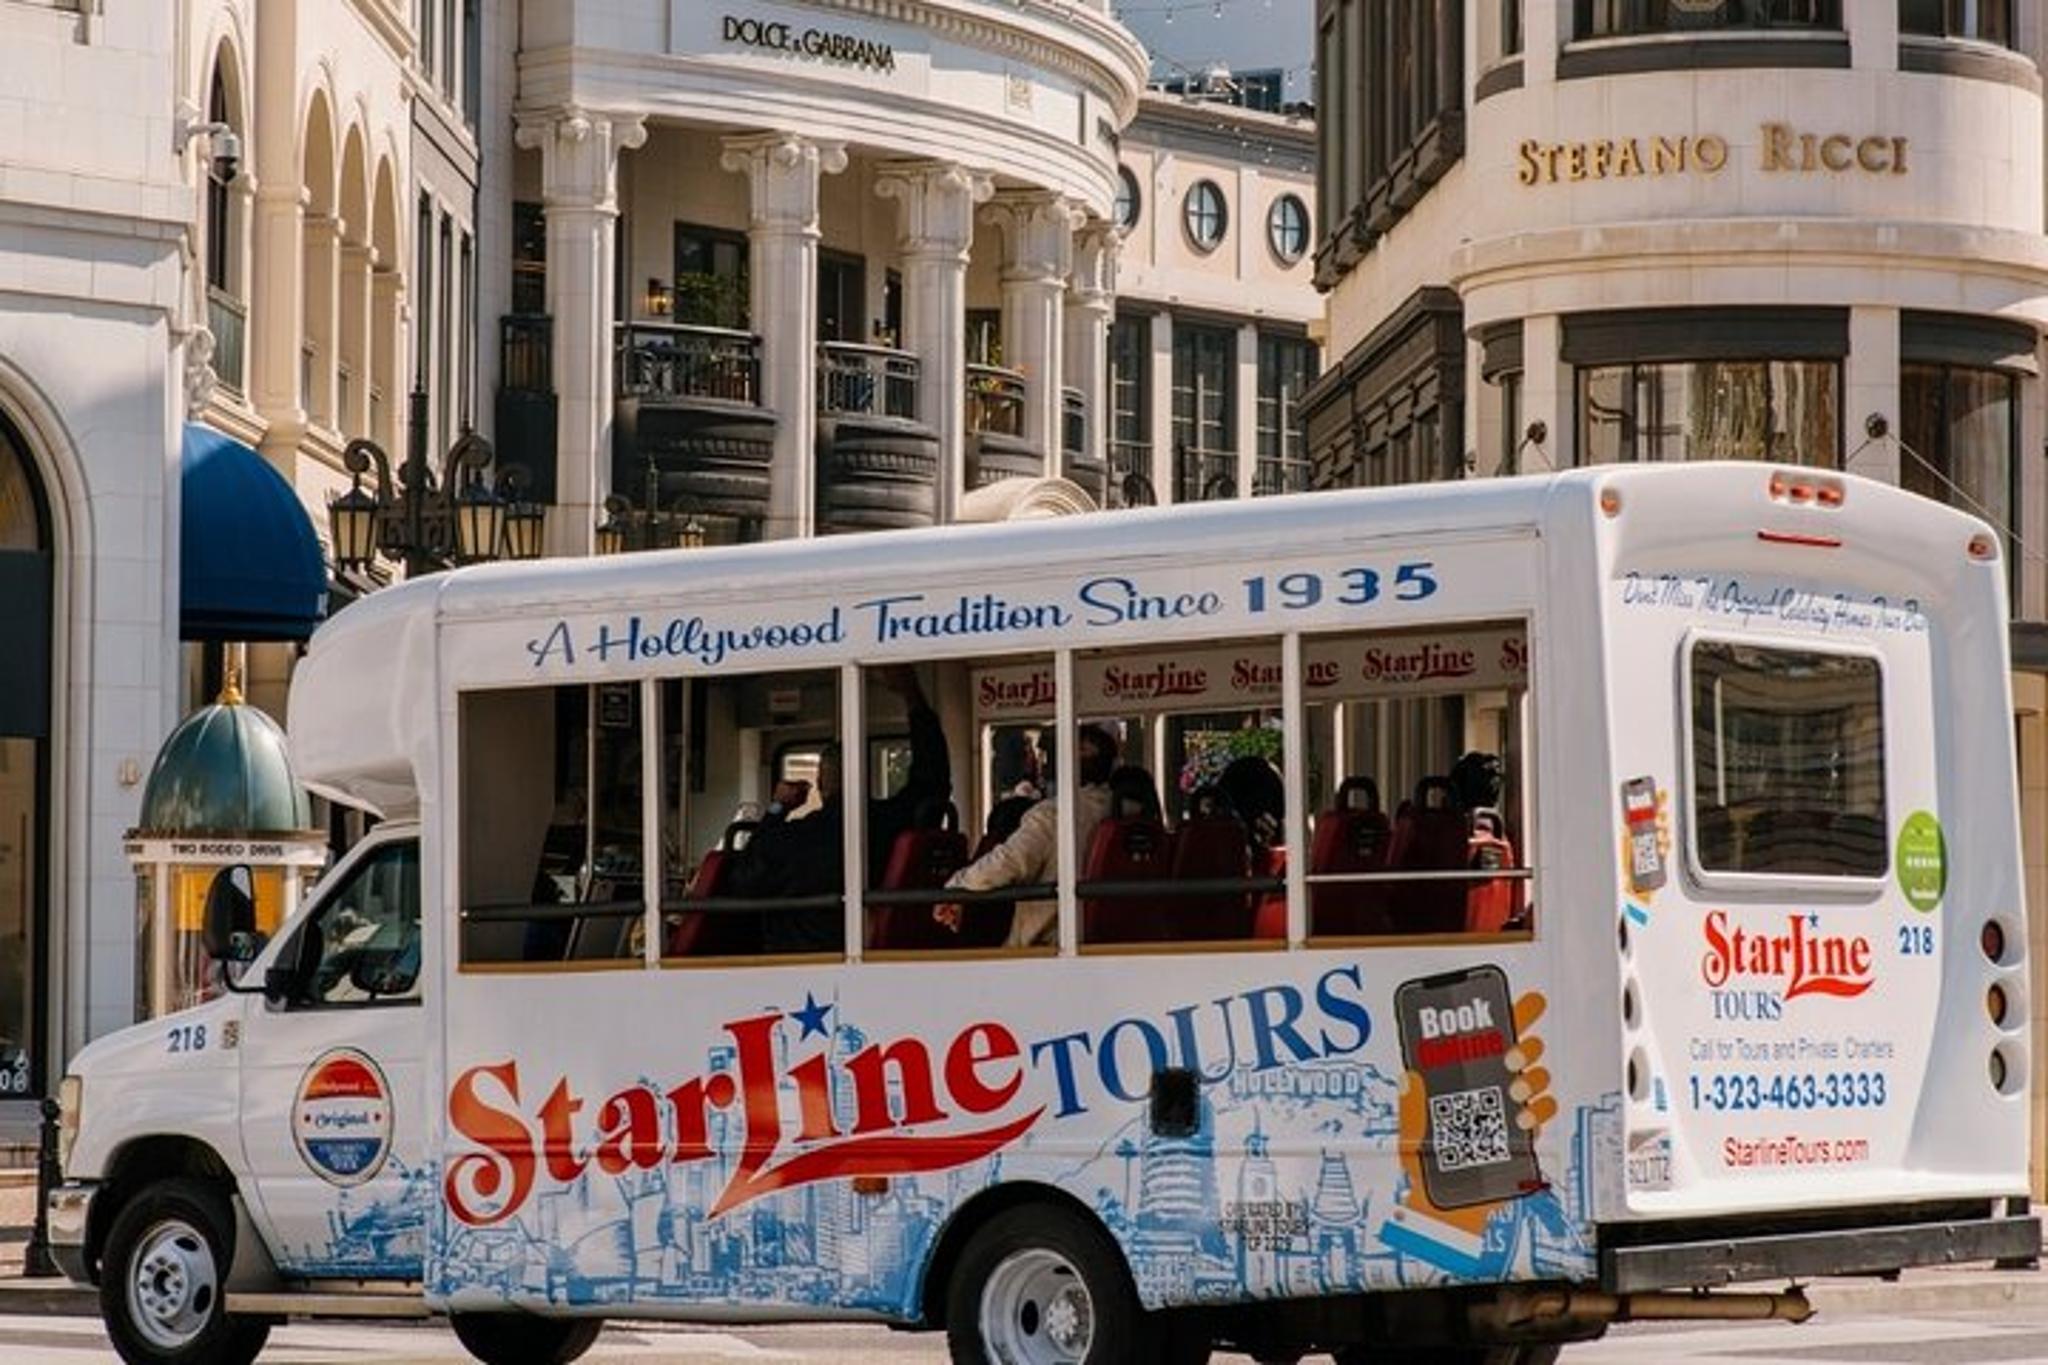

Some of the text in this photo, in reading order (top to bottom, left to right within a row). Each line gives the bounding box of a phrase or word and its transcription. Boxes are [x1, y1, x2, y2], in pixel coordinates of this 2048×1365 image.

[724, 16, 792, 51] DOLCE
[803, 29, 896, 70] GABBANA
[1519, 121, 1909, 186] STEFANO RICCI
[527, 562, 1438, 667] A Hollywood Tradition Since 1935
[171, 843, 283, 857] TWO RODEO DRIVE
[1899, 925, 1935, 955] 218
[1418, 997, 1495, 1040] Book
[1711, 991, 1783, 1021] TOURS
[166, 1023, 206, 1053] 218
[1030, 963, 1373, 1120] TOURS
[1689, 1037, 1713, 1061] Call
[1717, 1037, 1734, 1061] for
[1773, 1038, 1796, 1060] and
[1690, 1072, 1887, 1111] 1-323-463-3333
[1723, 1135, 1870, 1168] StarlineTours.com
